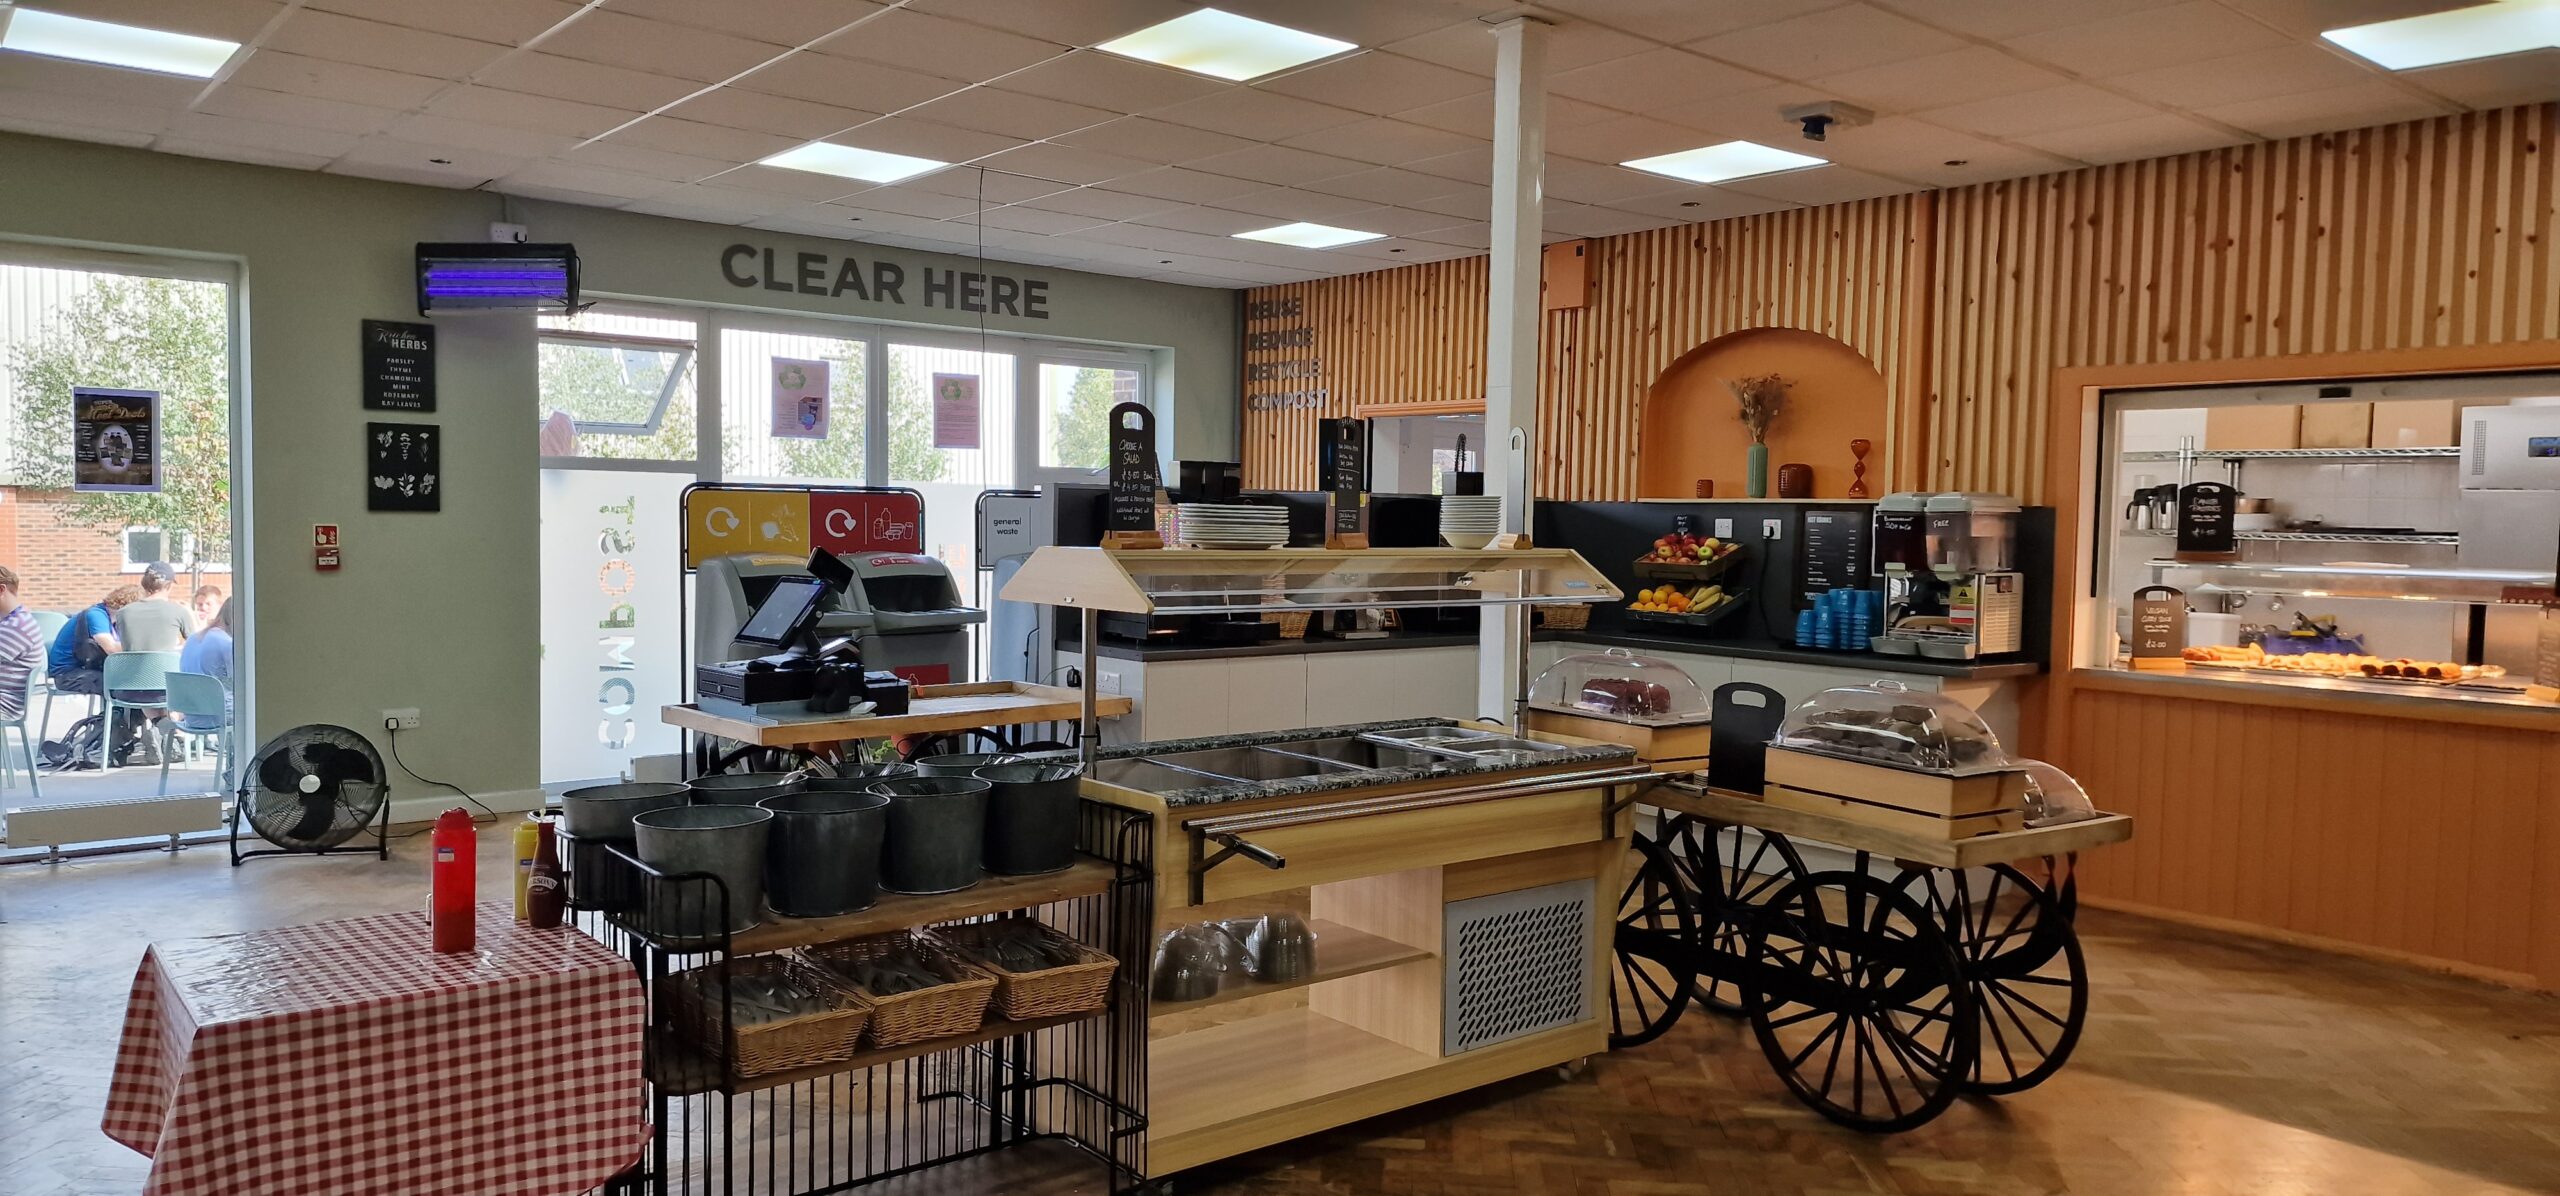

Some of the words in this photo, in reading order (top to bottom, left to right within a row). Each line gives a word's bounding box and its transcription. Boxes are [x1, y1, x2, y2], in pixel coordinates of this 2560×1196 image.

[721, 243, 905, 305] CLEAR
[924, 267, 1049, 320] HERE
[1249, 298, 1302, 320] REUSE
[391, 338, 427, 351] HERBS
[1248, 327, 1313, 351] REDUCE
[386, 357, 415, 365] PARSLEY
[1248, 358, 1321, 381] RECYCLE
[380, 374, 421, 382] CHAMOMILE
[383, 391, 420, 399] ROSEMARY
[1247, 388, 1328, 412] COMPOST
[397, 400, 421, 408] LEAVES
[1122, 452, 1140, 465] SALAD
[993, 517, 1022, 526] general
